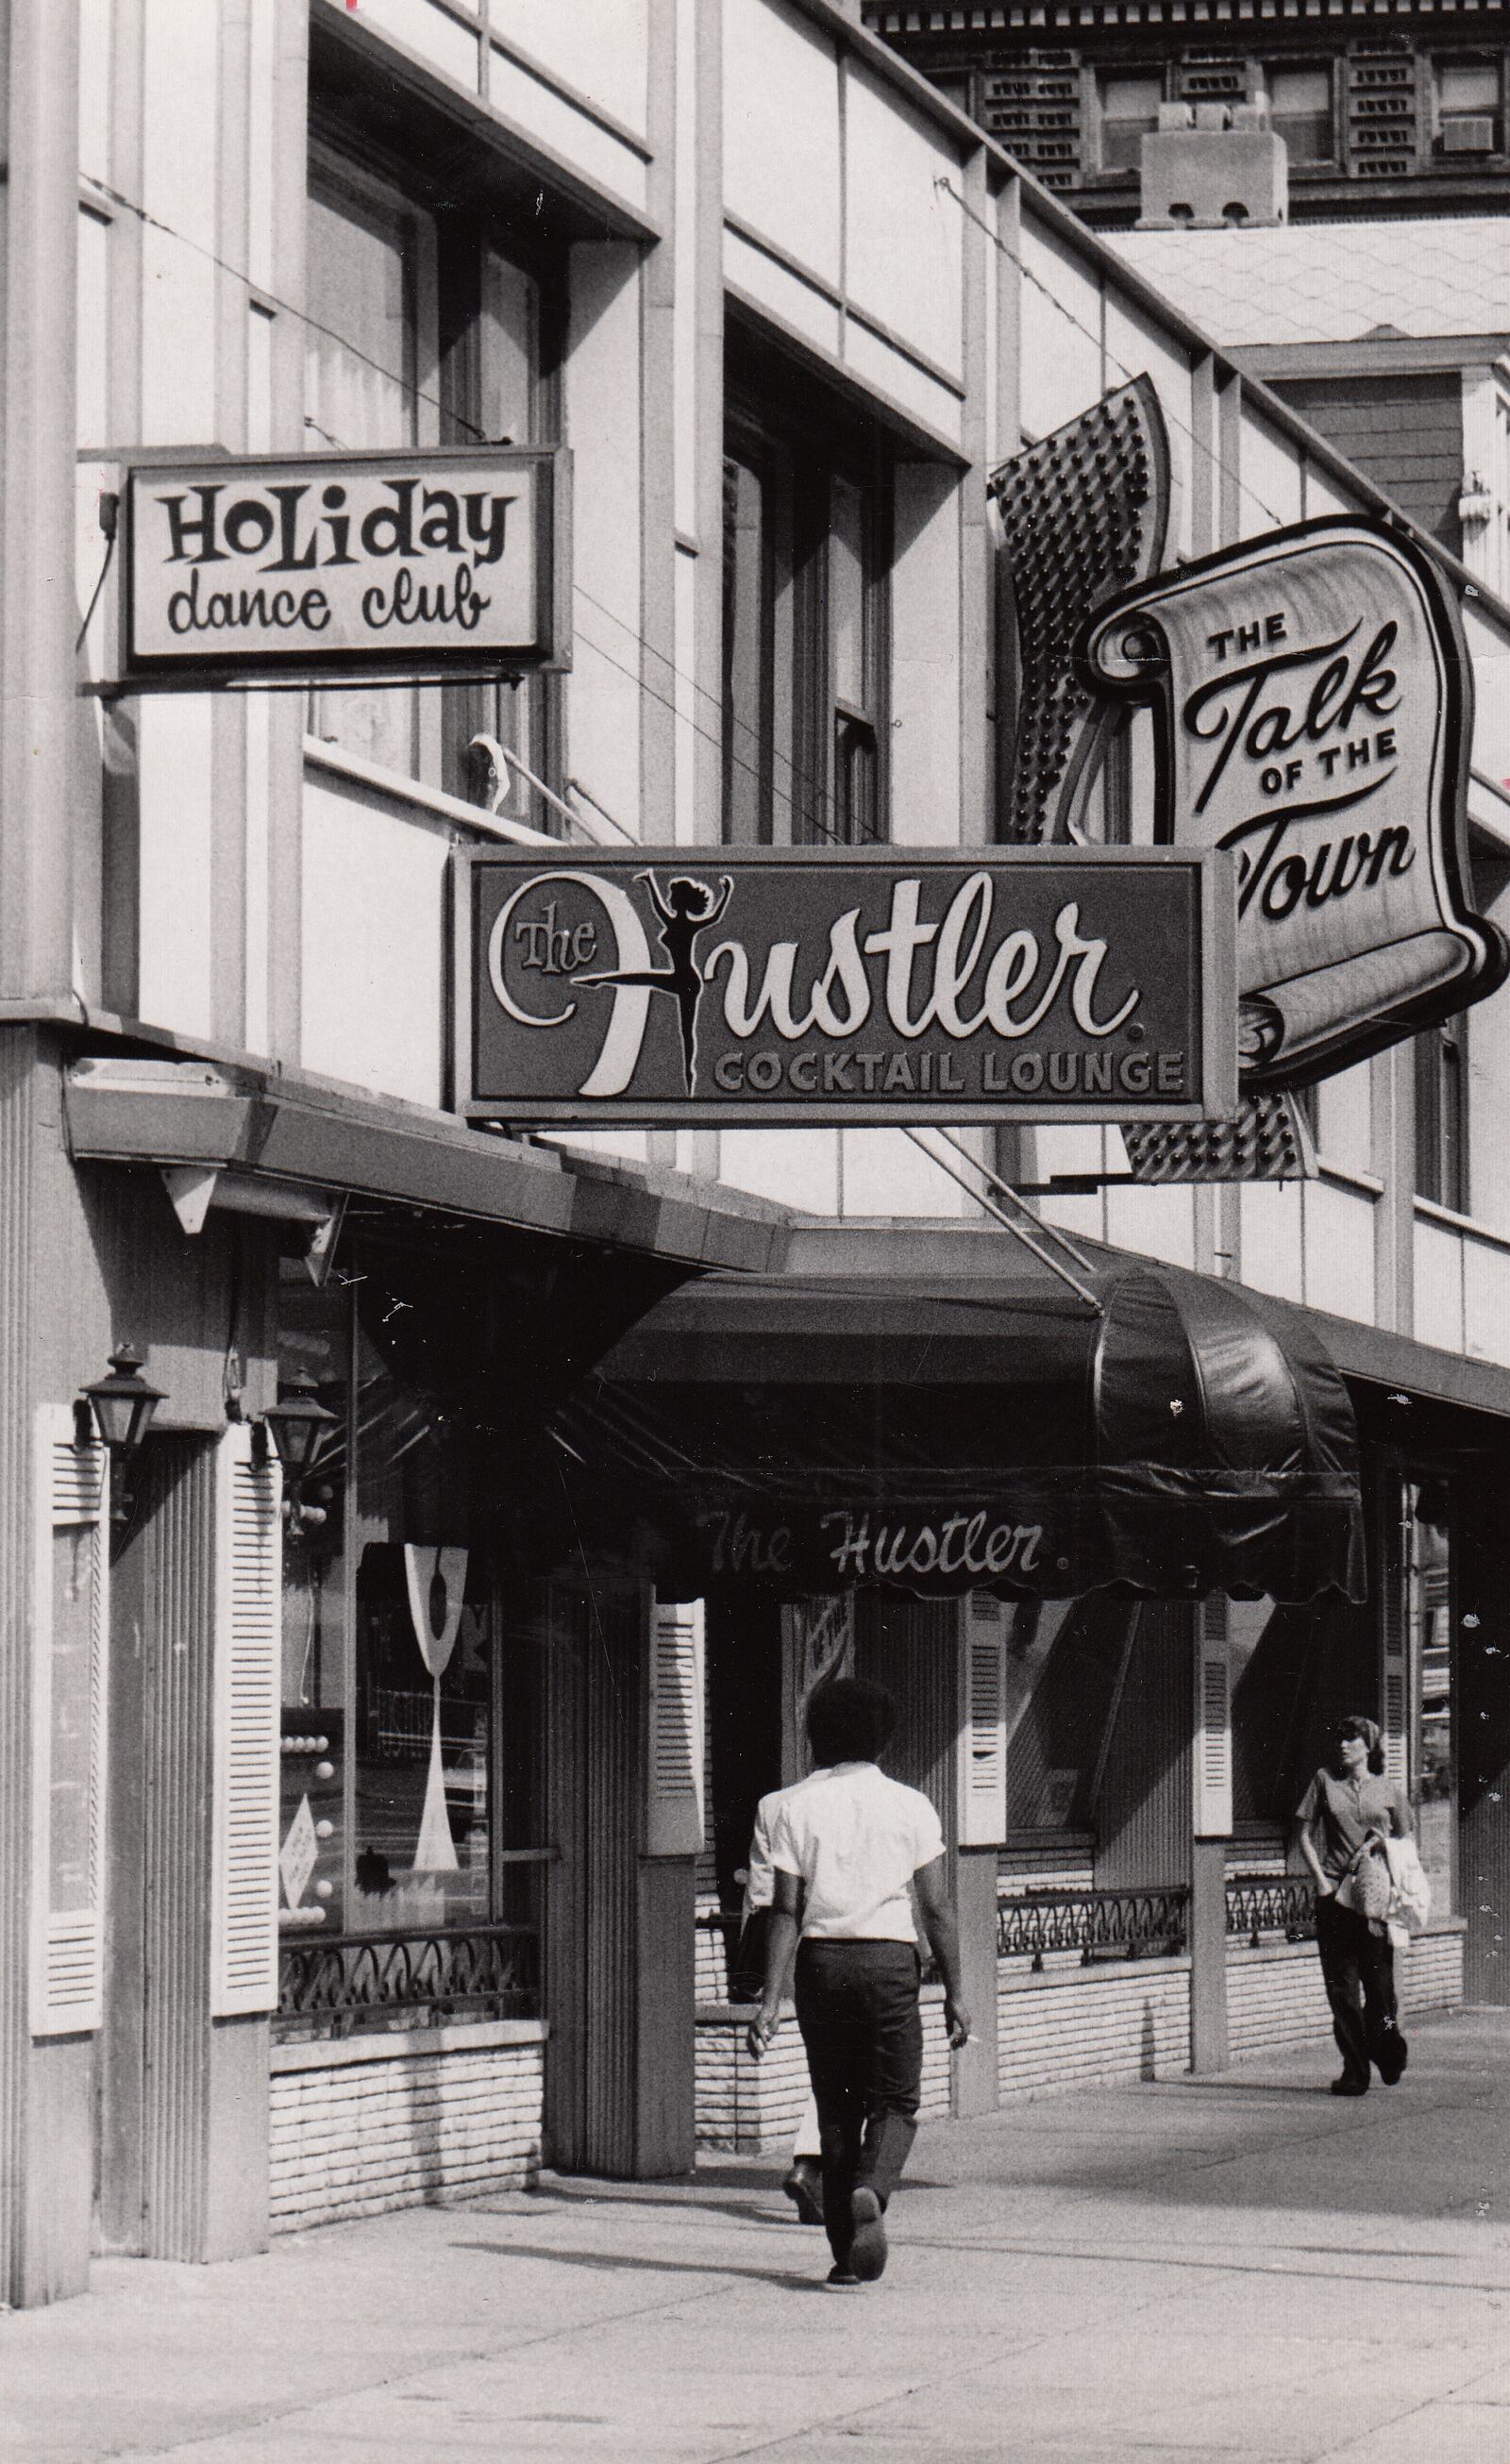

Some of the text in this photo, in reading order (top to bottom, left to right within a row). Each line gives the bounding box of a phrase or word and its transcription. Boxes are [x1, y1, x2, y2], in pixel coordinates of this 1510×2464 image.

[166, 563, 492, 634] dance club
[1206, 612, 1288, 662] THE
[1183, 613, 1404, 814] Talk
[1261, 728, 1400, 796] OF THE
[1216, 765, 1418, 921] Town
[513, 901, 599, 977] The
[713, 1049, 1185, 1092] COCKTAIL LOUNGE
[696, 1509, 1044, 1574] The Hustler
